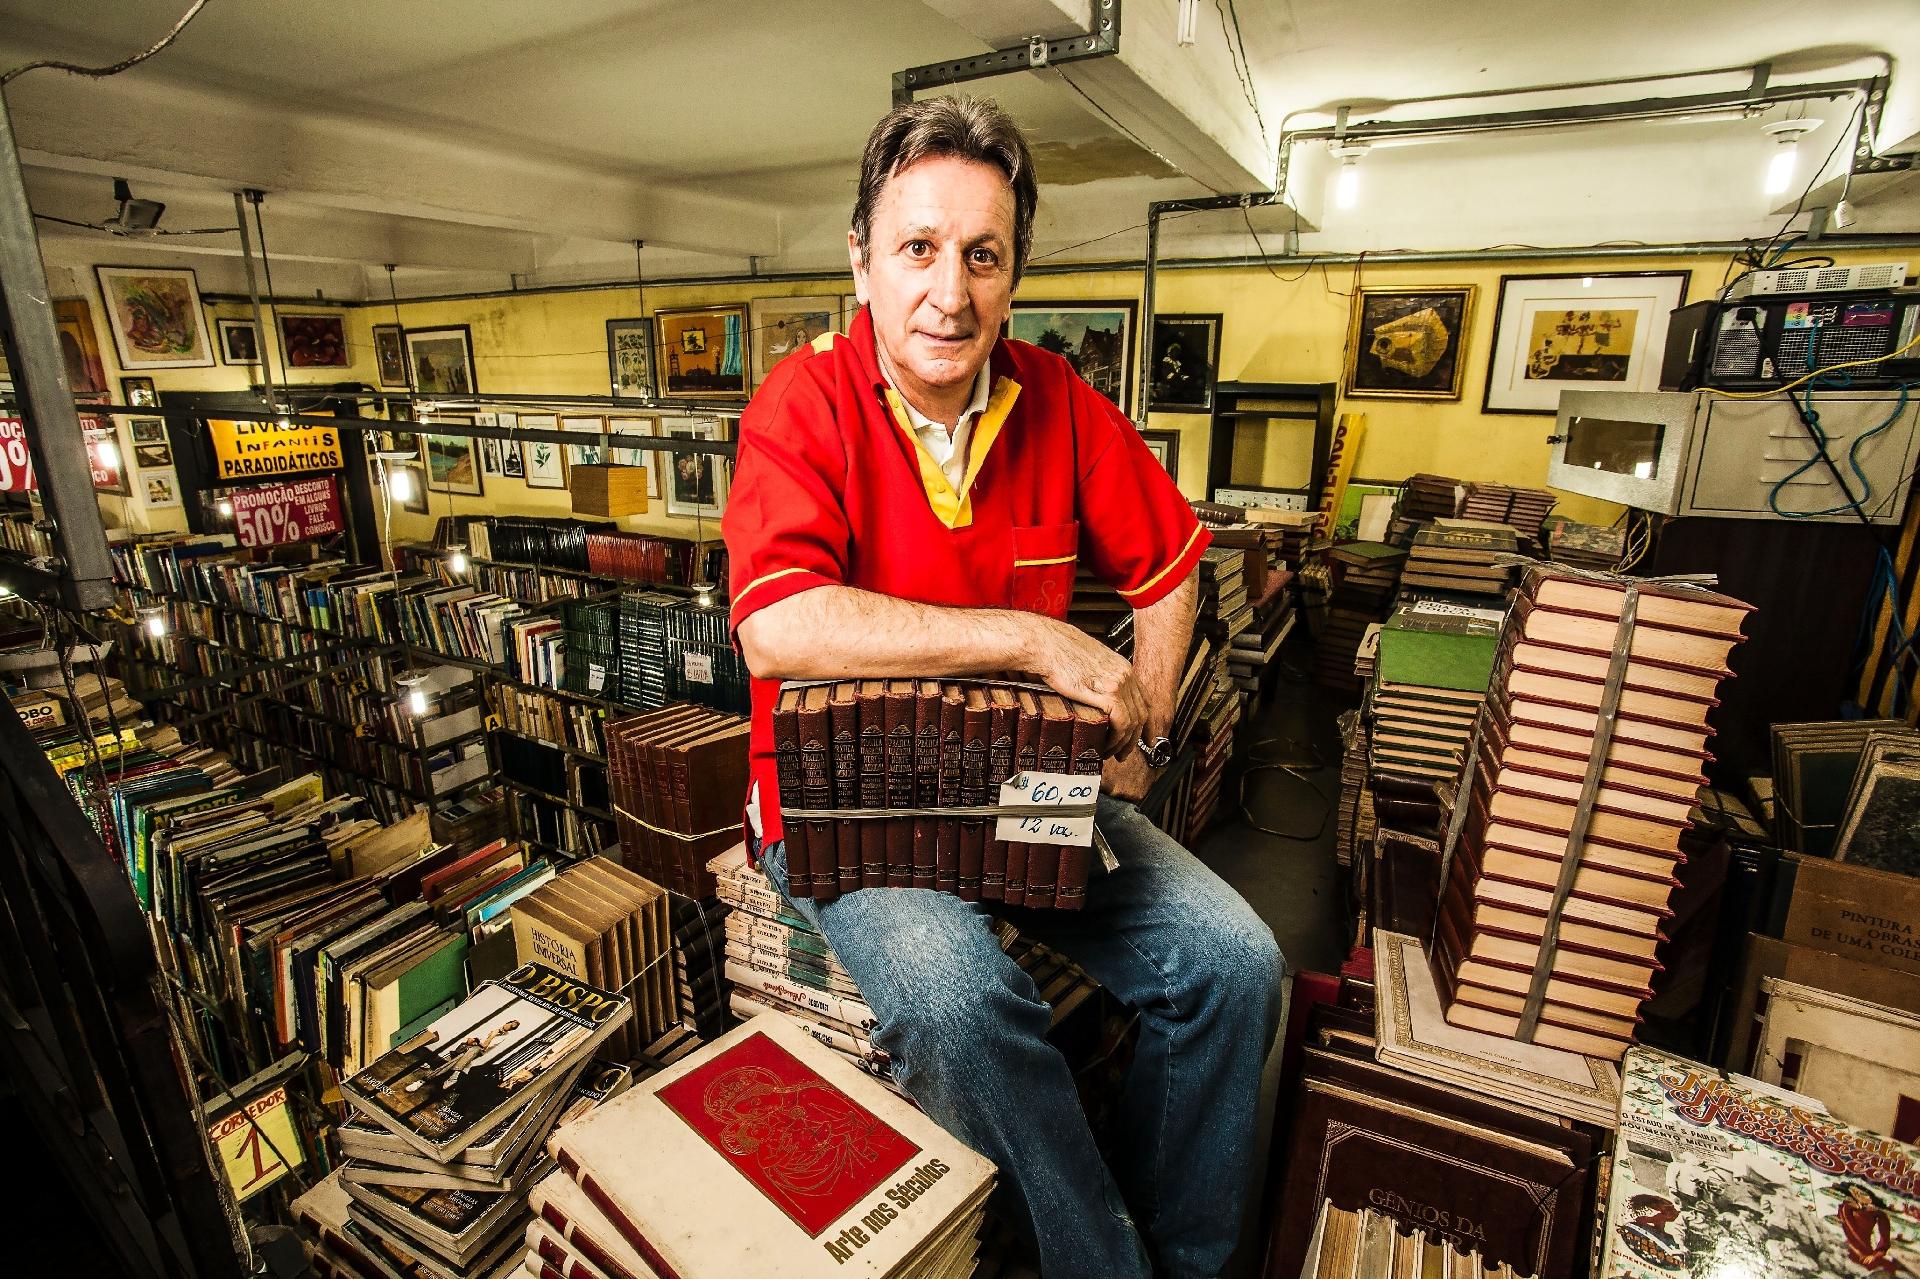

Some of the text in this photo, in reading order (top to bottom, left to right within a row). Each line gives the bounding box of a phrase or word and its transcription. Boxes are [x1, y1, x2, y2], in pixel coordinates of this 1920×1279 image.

[224, 451, 338, 476] PARADIDÁTICOS
[233, 487, 295, 510] PROMOÇÃO
[294, 480, 330, 495] DESCONTO
[236, 503, 300, 547] 50%
[304, 521, 336, 536] CONOSCO
[309, 512, 324, 524] FALE
[1032, 781, 1092, 805] 60,00
[1840, 910, 1911, 934] PINTURA
[1811, 927, 1832, 939] DE
[1837, 933, 1872, 949] UMA
[533, 941, 579, 977] UNIVERSAL
[506, 965, 623, 1022] O BISPO
[208, 1090, 284, 1140] COREDOR
[1619, 1121, 1680, 1141] MOVIMENTO
[1686, 1137, 1728, 1153] MILITAR
[1690, 1130, 1718, 1143] PAULO
[234, 1126, 282, 1191] 1
[824, 1158, 951, 1265] Arte nos Séculos
[1368, 1188, 1450, 1227] GÊNIOS
[1455, 1216, 1487, 1242] DA
